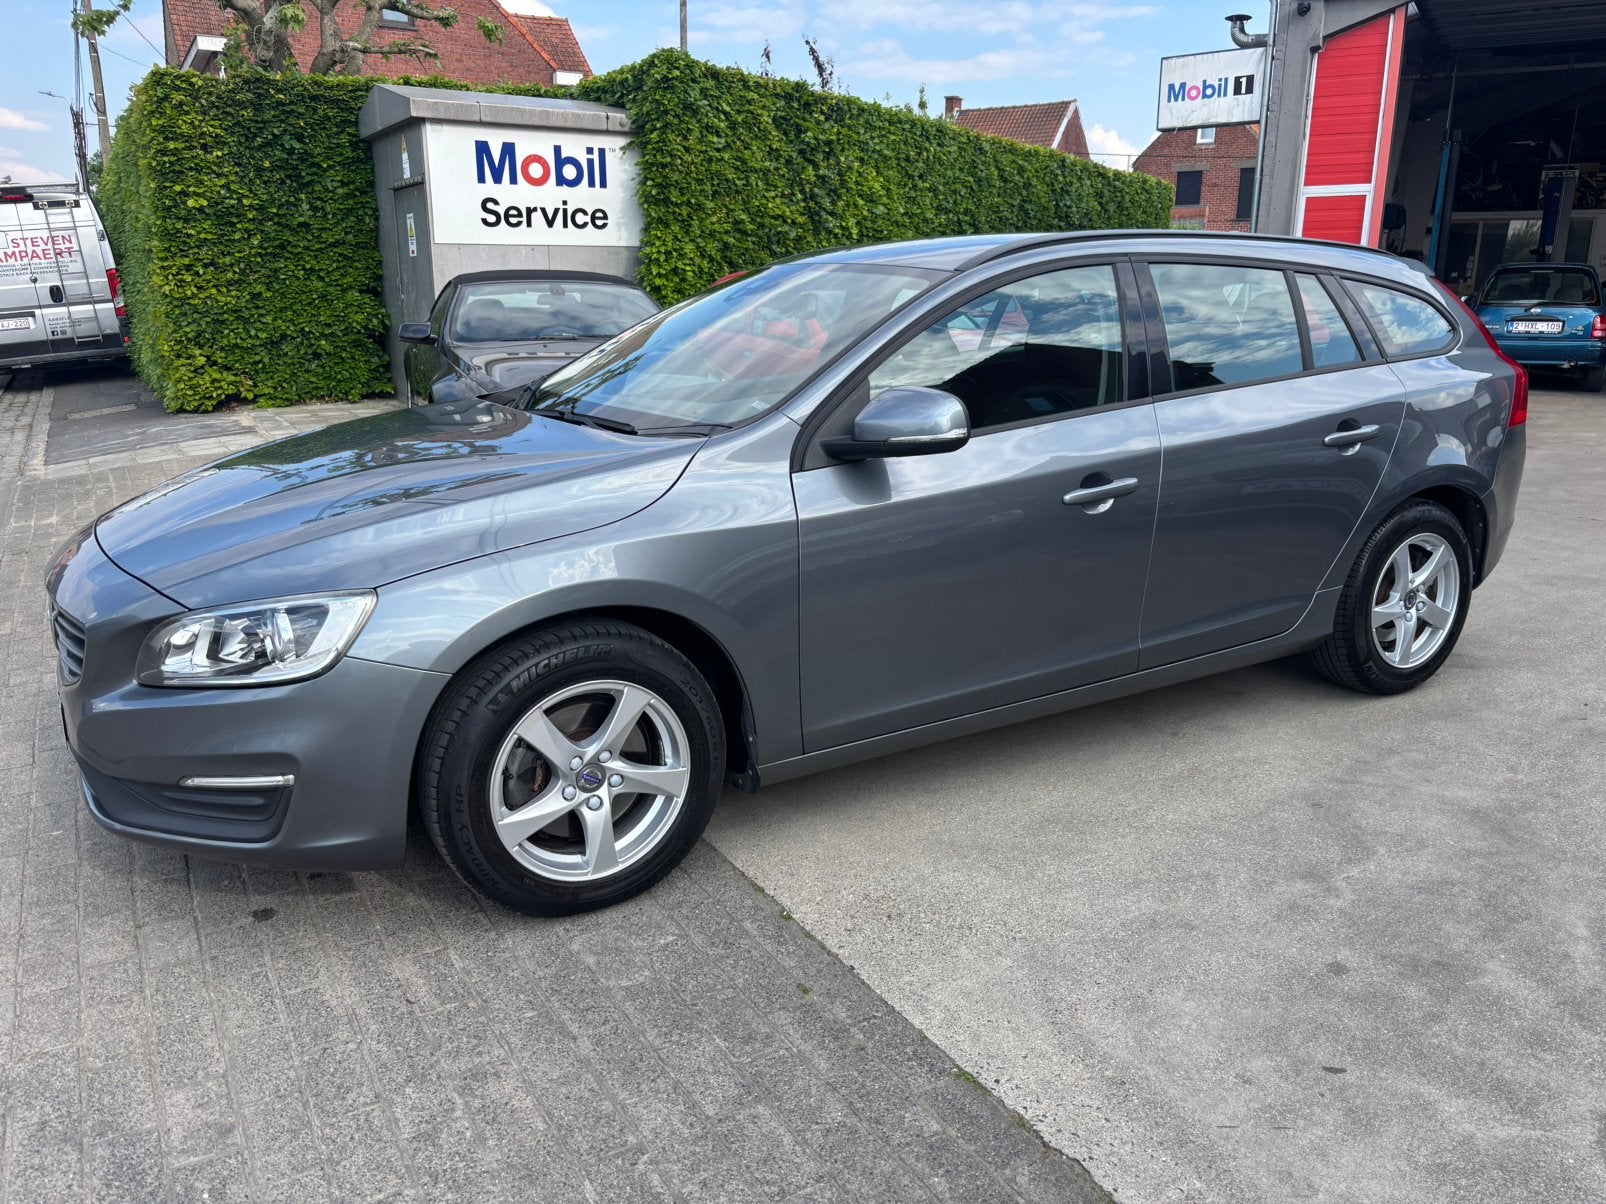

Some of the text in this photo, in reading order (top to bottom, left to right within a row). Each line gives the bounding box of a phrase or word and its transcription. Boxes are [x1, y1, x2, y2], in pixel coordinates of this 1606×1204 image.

[1167, 77, 1229, 103] Mobil
[475, 139, 608, 189] Mobil
[480, 197, 609, 230] Service
[10, 234, 73, 248] STEVEN
[508, 643, 617, 694] MICHELIN
